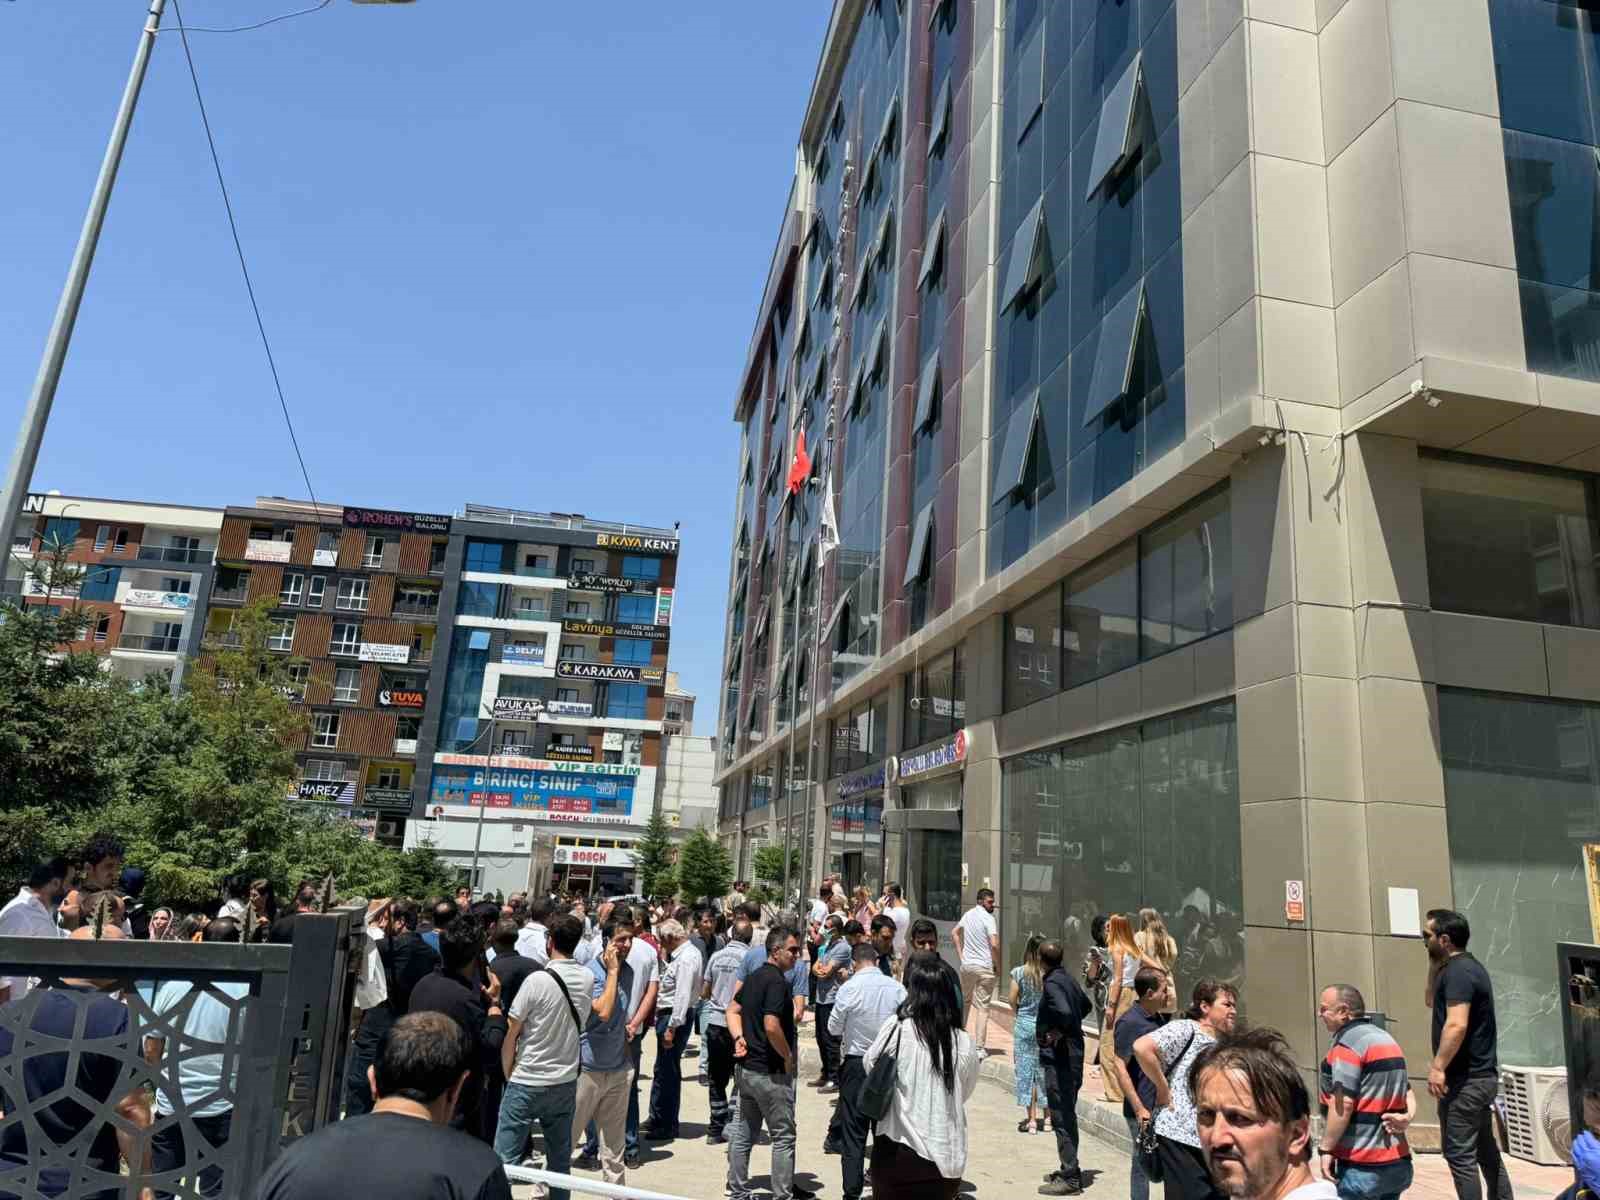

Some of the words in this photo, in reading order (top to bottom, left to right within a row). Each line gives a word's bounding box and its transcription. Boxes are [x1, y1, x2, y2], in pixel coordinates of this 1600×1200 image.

[610, 535, 641, 547] KAYA
[644, 539, 678, 550] KENT
[574, 664, 635, 679] KARAKAYA
[392, 691, 424, 703] TUVA
[494, 699, 538, 711] AVUKAT
[299, 783, 339, 797] HAREZ
[538, 775, 583, 792] SINIF
[572, 851, 607, 863] BOSCH
